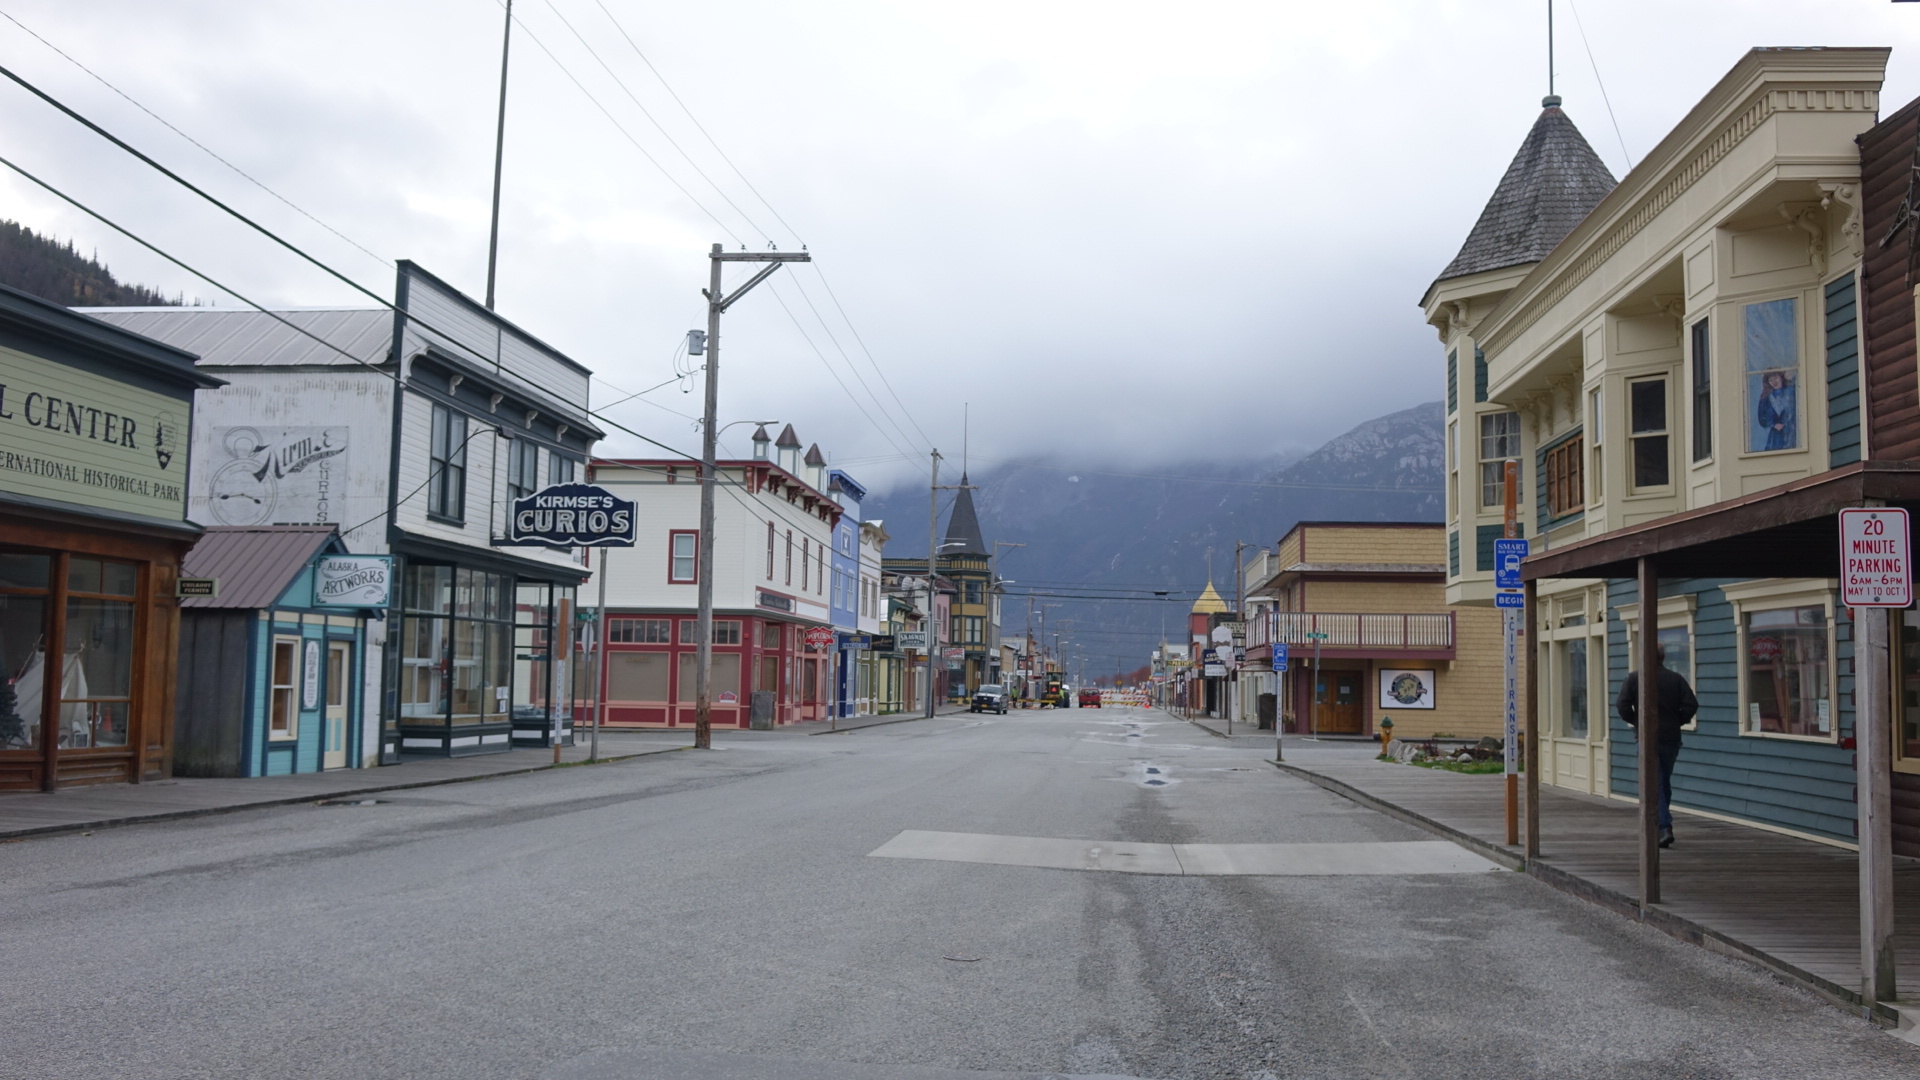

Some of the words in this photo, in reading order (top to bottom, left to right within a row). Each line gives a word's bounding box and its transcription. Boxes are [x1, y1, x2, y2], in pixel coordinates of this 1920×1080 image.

[83, 468, 150, 496] HISTORICAL
[153, 483, 181, 501] PARK
[536, 495, 614, 508] KIRMSE'S
[516, 509, 630, 533] CURIOS
[1863, 519, 1884, 536] 20
[1853, 539, 1896, 554] MINUTE
[327, 562, 359, 572] ALASKA
[1849, 558, 1901, 573] PARKING
[322, 570, 384, 594] ARTWORKS
[1850, 574, 1872, 585] 6AM
[1881, 574, 1903, 585] 6PM
[1848, 586, 1864, 596] MAY
[1873, 587, 1883, 596] TO
[1886, 587, 1900, 596] OCT
[808, 632, 830, 640] POPCORN
